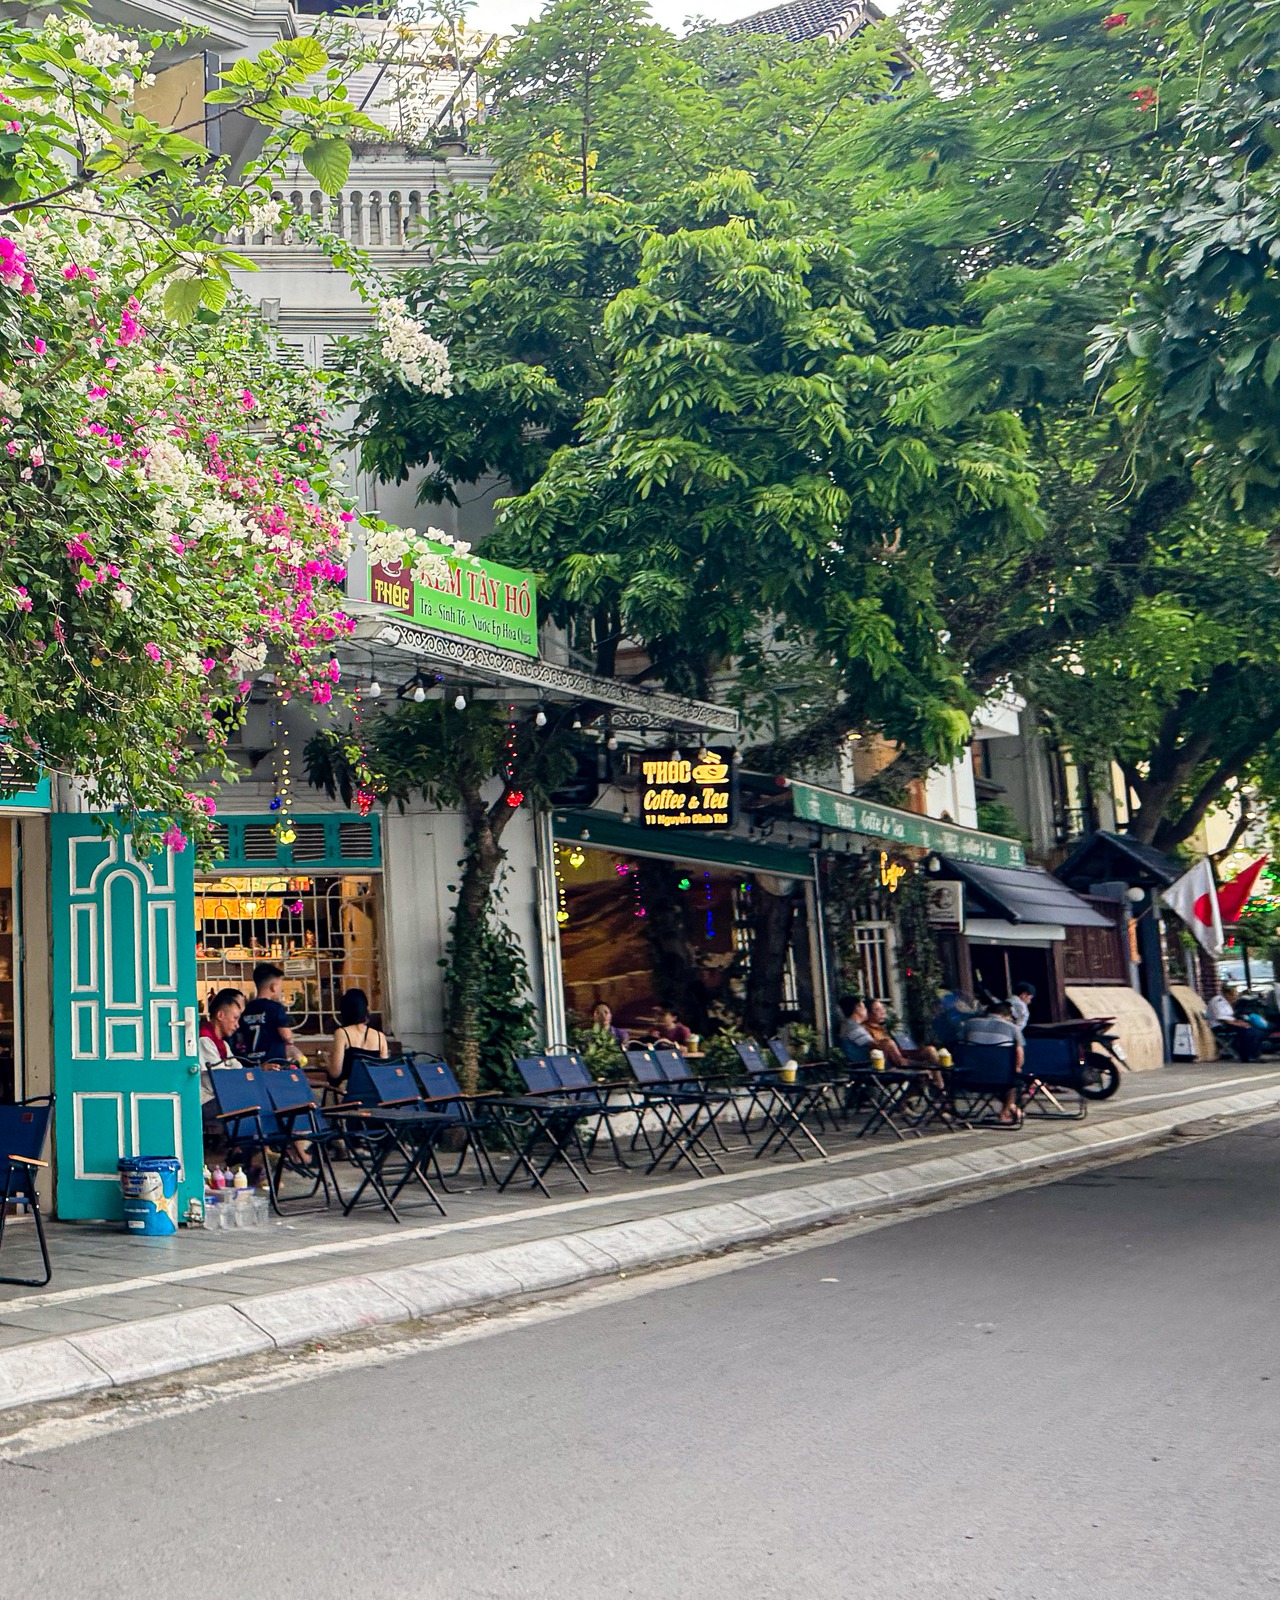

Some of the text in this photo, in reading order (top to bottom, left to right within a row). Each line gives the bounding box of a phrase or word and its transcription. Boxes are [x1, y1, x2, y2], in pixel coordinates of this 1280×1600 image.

[374, 579, 410, 610] THÓC
[467, 569, 500, 608] TÂY
[438, 604, 455, 623] Sinh
[503, 622, 516, 640] Hoa
[643, 787, 729, 810] Coffee & Tea
[645, 814, 656, 825] 11
